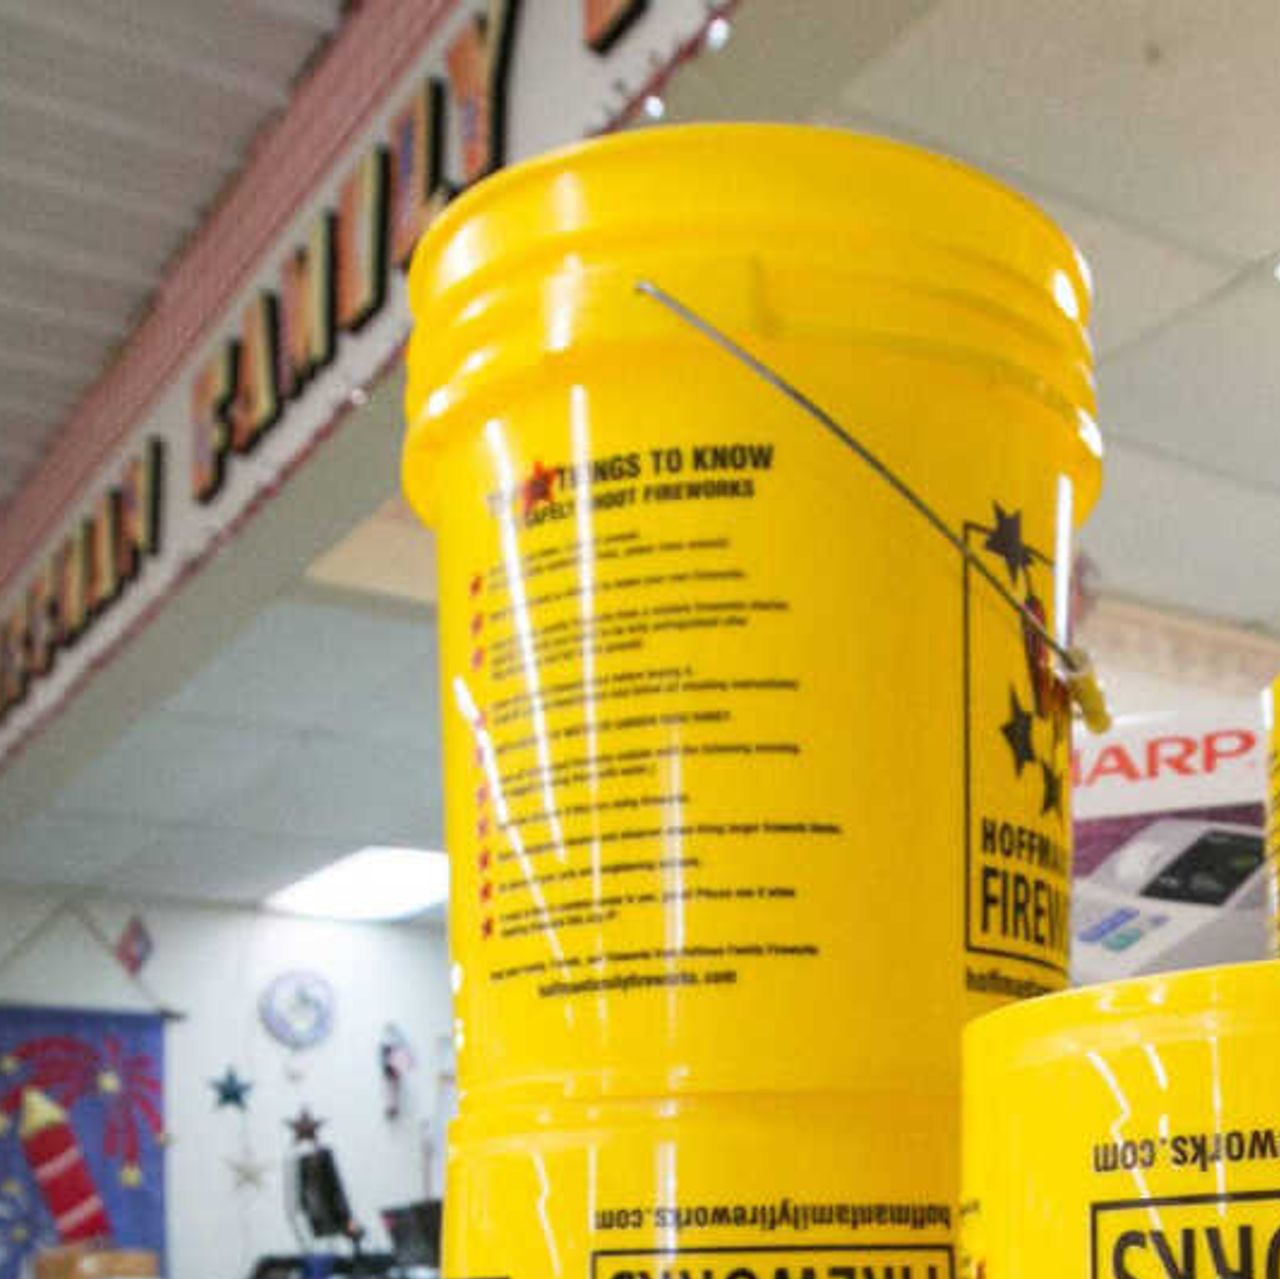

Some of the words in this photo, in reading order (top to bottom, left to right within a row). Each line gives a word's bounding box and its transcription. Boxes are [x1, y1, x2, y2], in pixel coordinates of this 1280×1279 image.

[651, 448, 683, 475] TO
[693, 443, 774, 472] KNOW
[643, 478, 755, 501] FIREWORKS
